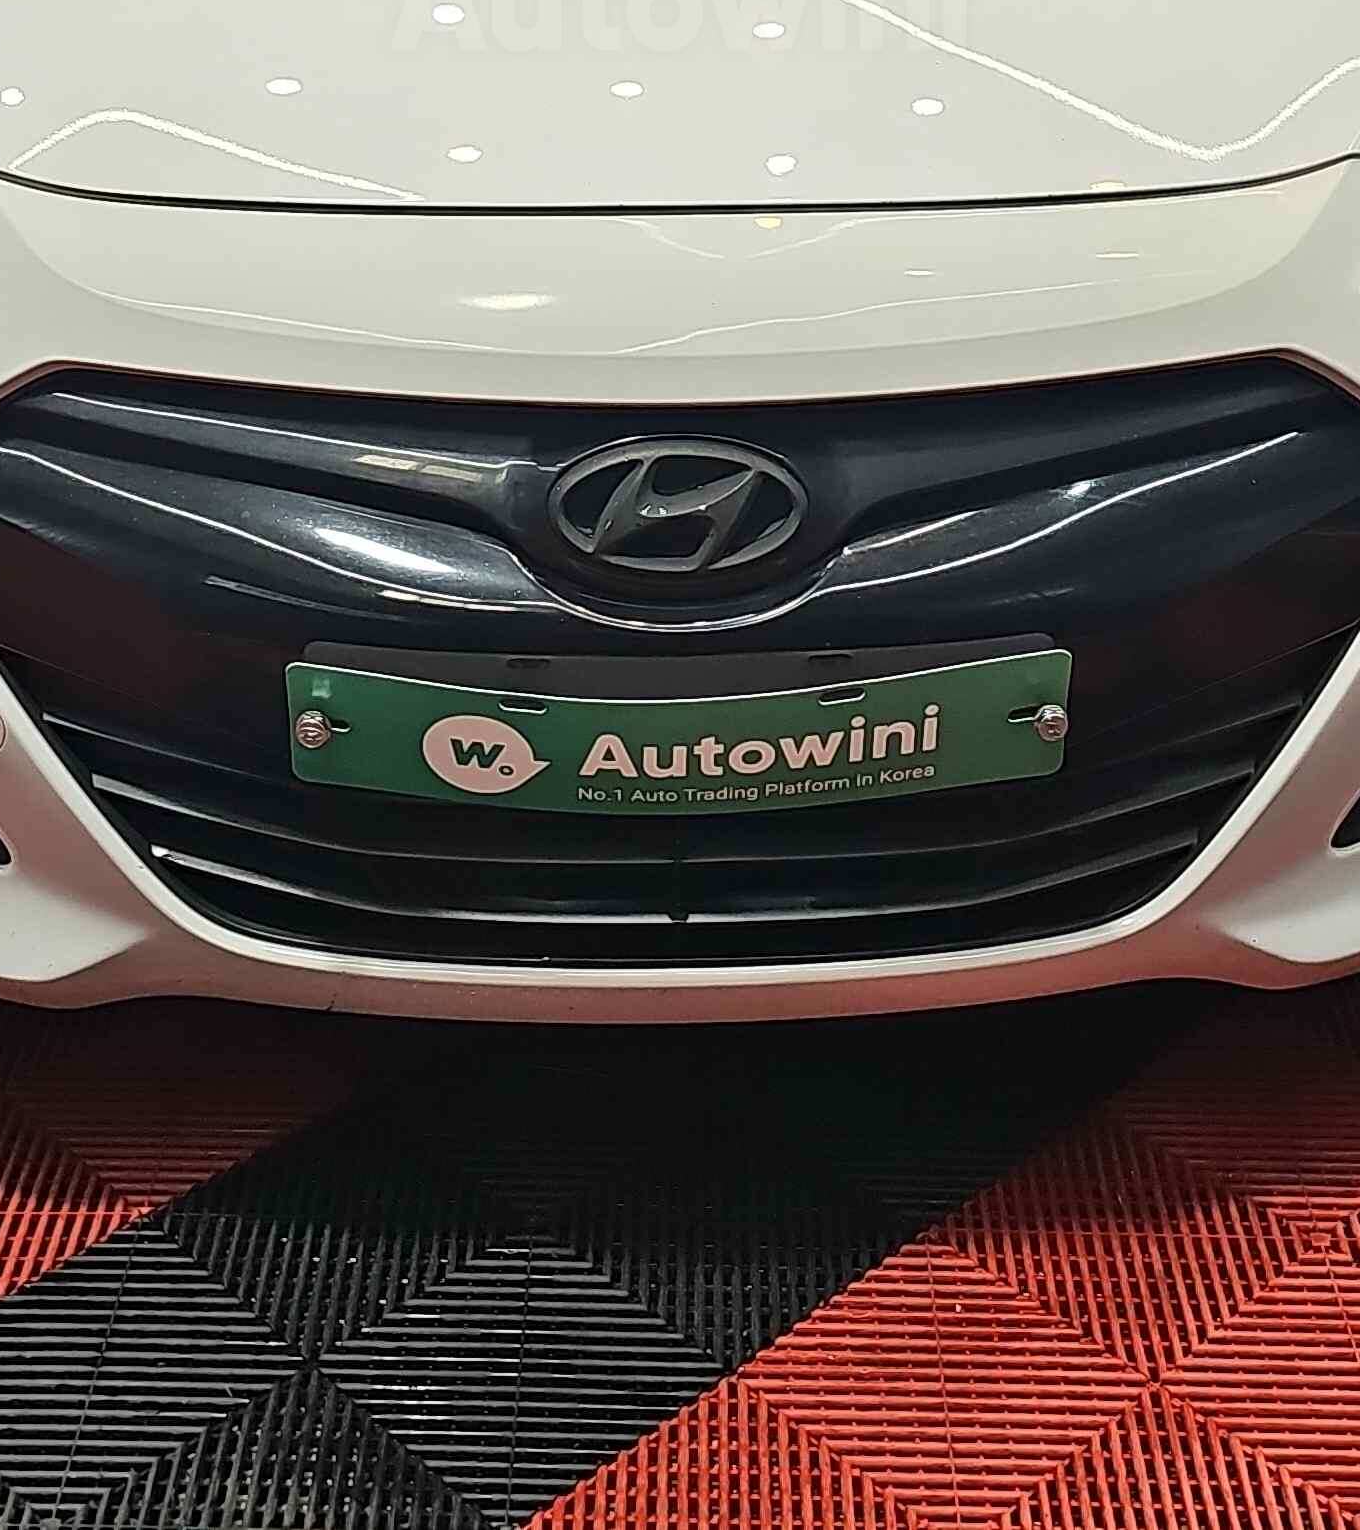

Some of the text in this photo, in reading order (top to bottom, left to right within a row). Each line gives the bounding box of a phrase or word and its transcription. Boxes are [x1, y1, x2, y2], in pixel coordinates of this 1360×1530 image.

[578, 704, 940, 779] Autowini
[577, 787, 623, 802] No.1
[630, 789, 678, 803] Auto
[684, 787, 758, 801] Trading
[765, 777, 850, 797] Platform
[879, 765, 936, 783] Korea
